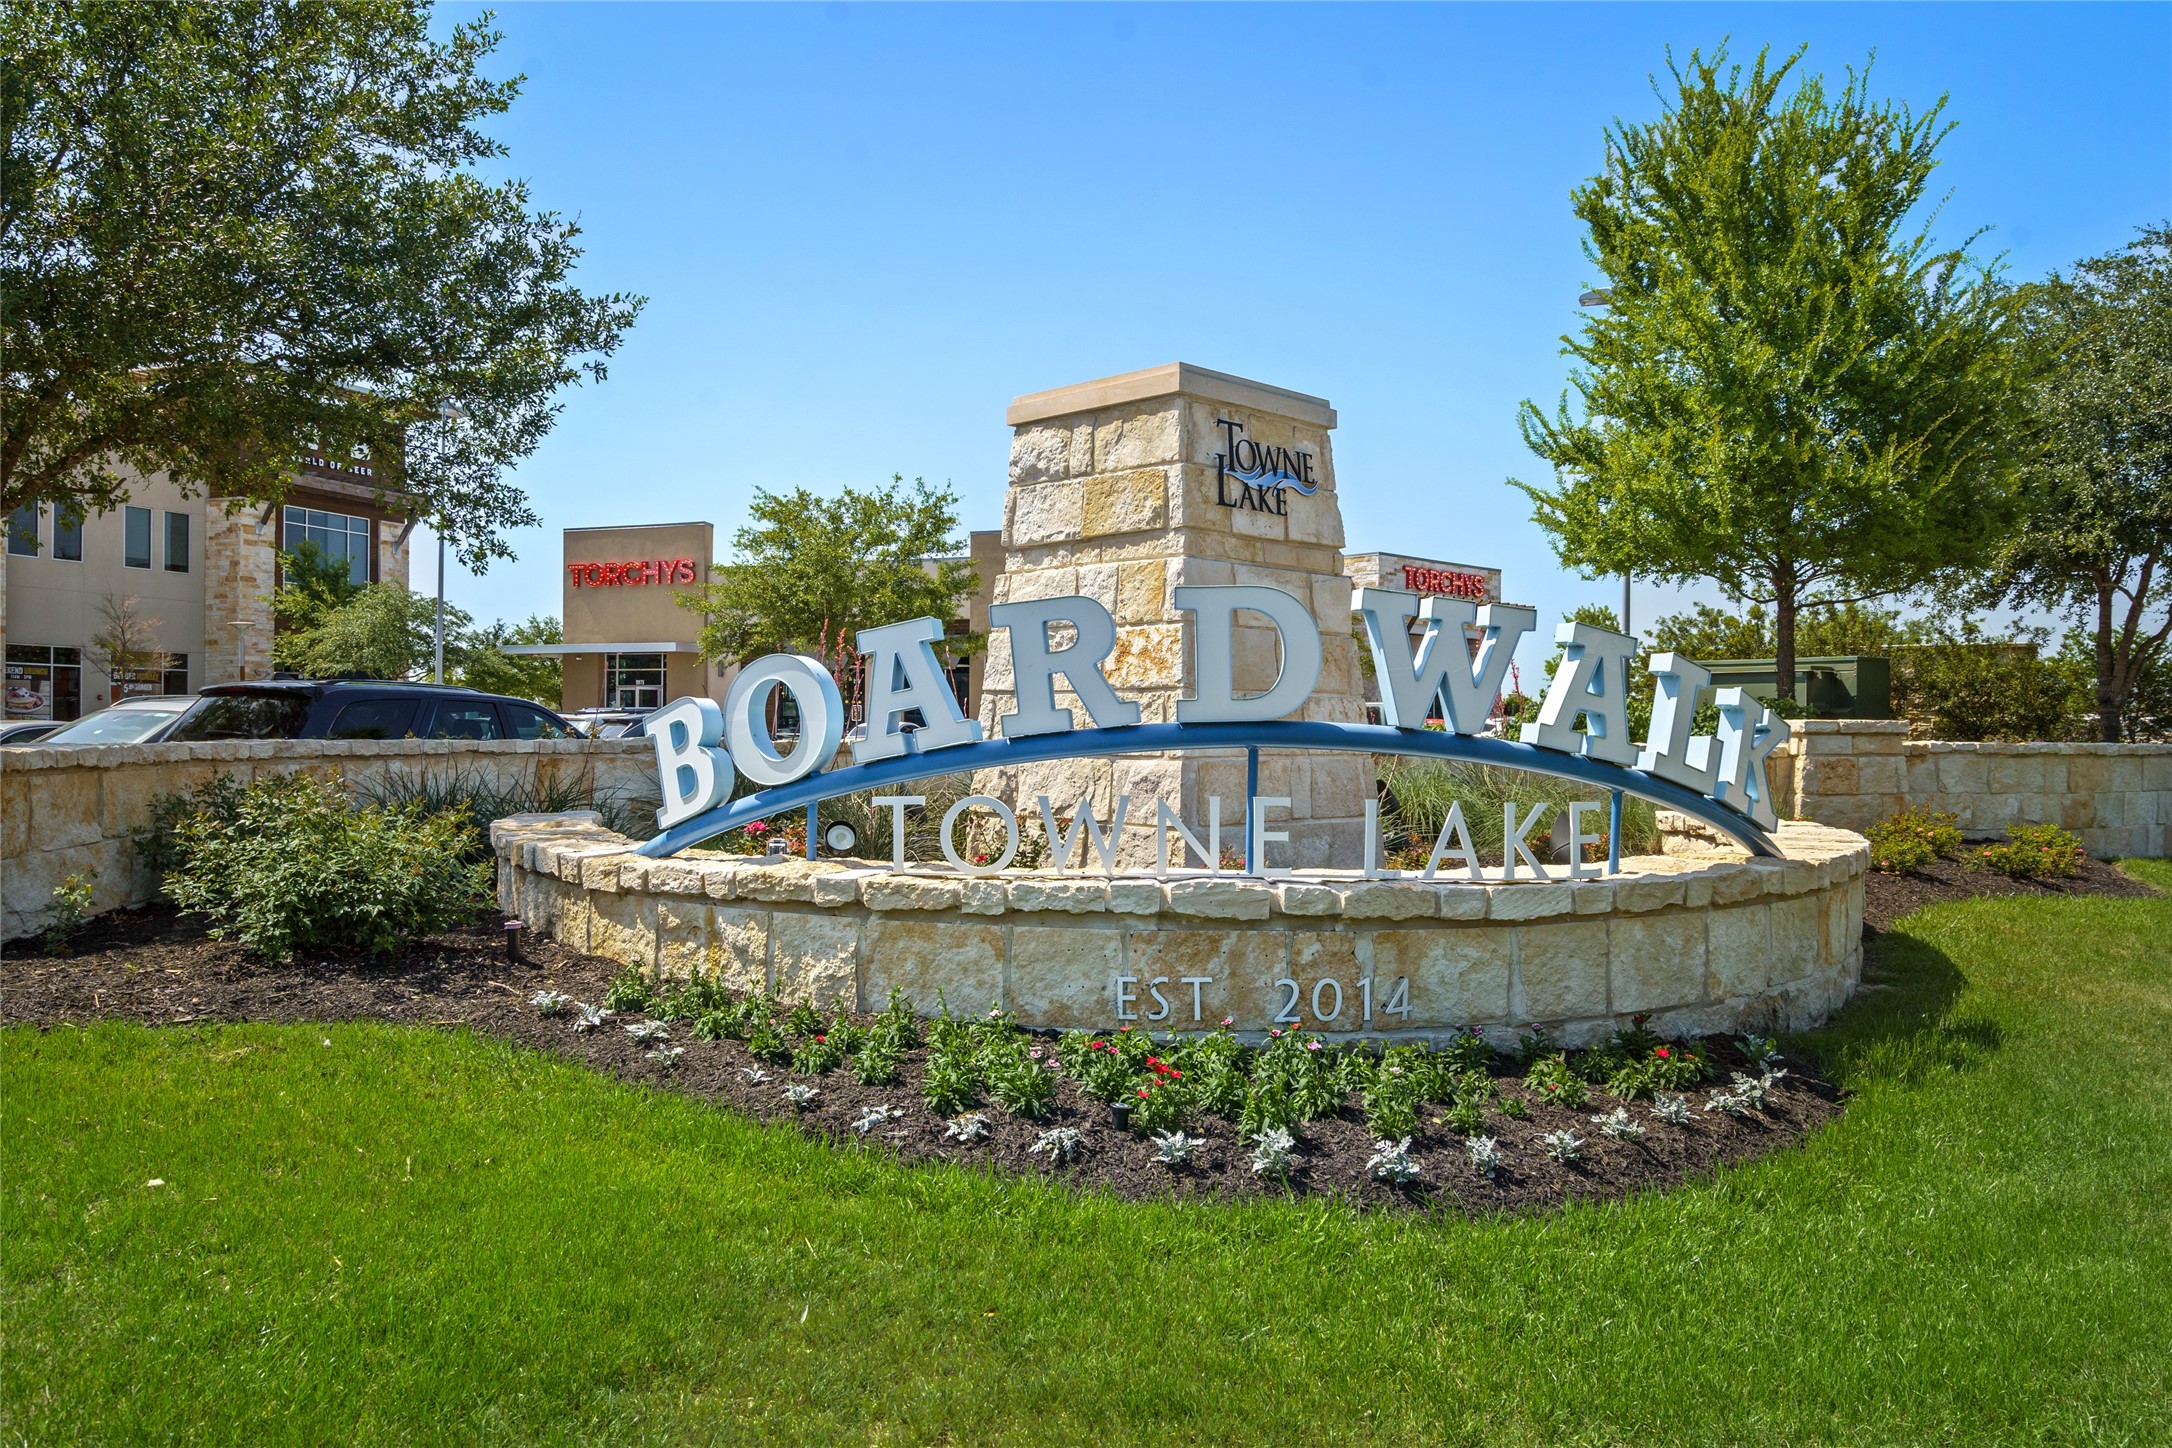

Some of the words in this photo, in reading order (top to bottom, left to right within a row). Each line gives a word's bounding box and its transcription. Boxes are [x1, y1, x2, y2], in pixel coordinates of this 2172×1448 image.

[330, 460, 342, 471] OF
[1216, 418, 1315, 484] TOWNE
[1215, 452, 1288, 516] LAKE
[567, 559, 697, 588] TORCHYS
[1402, 564, 1486, 598] TORCHYS
[643, 584, 1790, 834] BOARDWALK
[872, 795, 1292, 878] TOWNE
[1365, 799, 1602, 881] LAKE
[1117, 976, 1213, 1021] EST
[1274, 977, 1414, 1023] 2014
